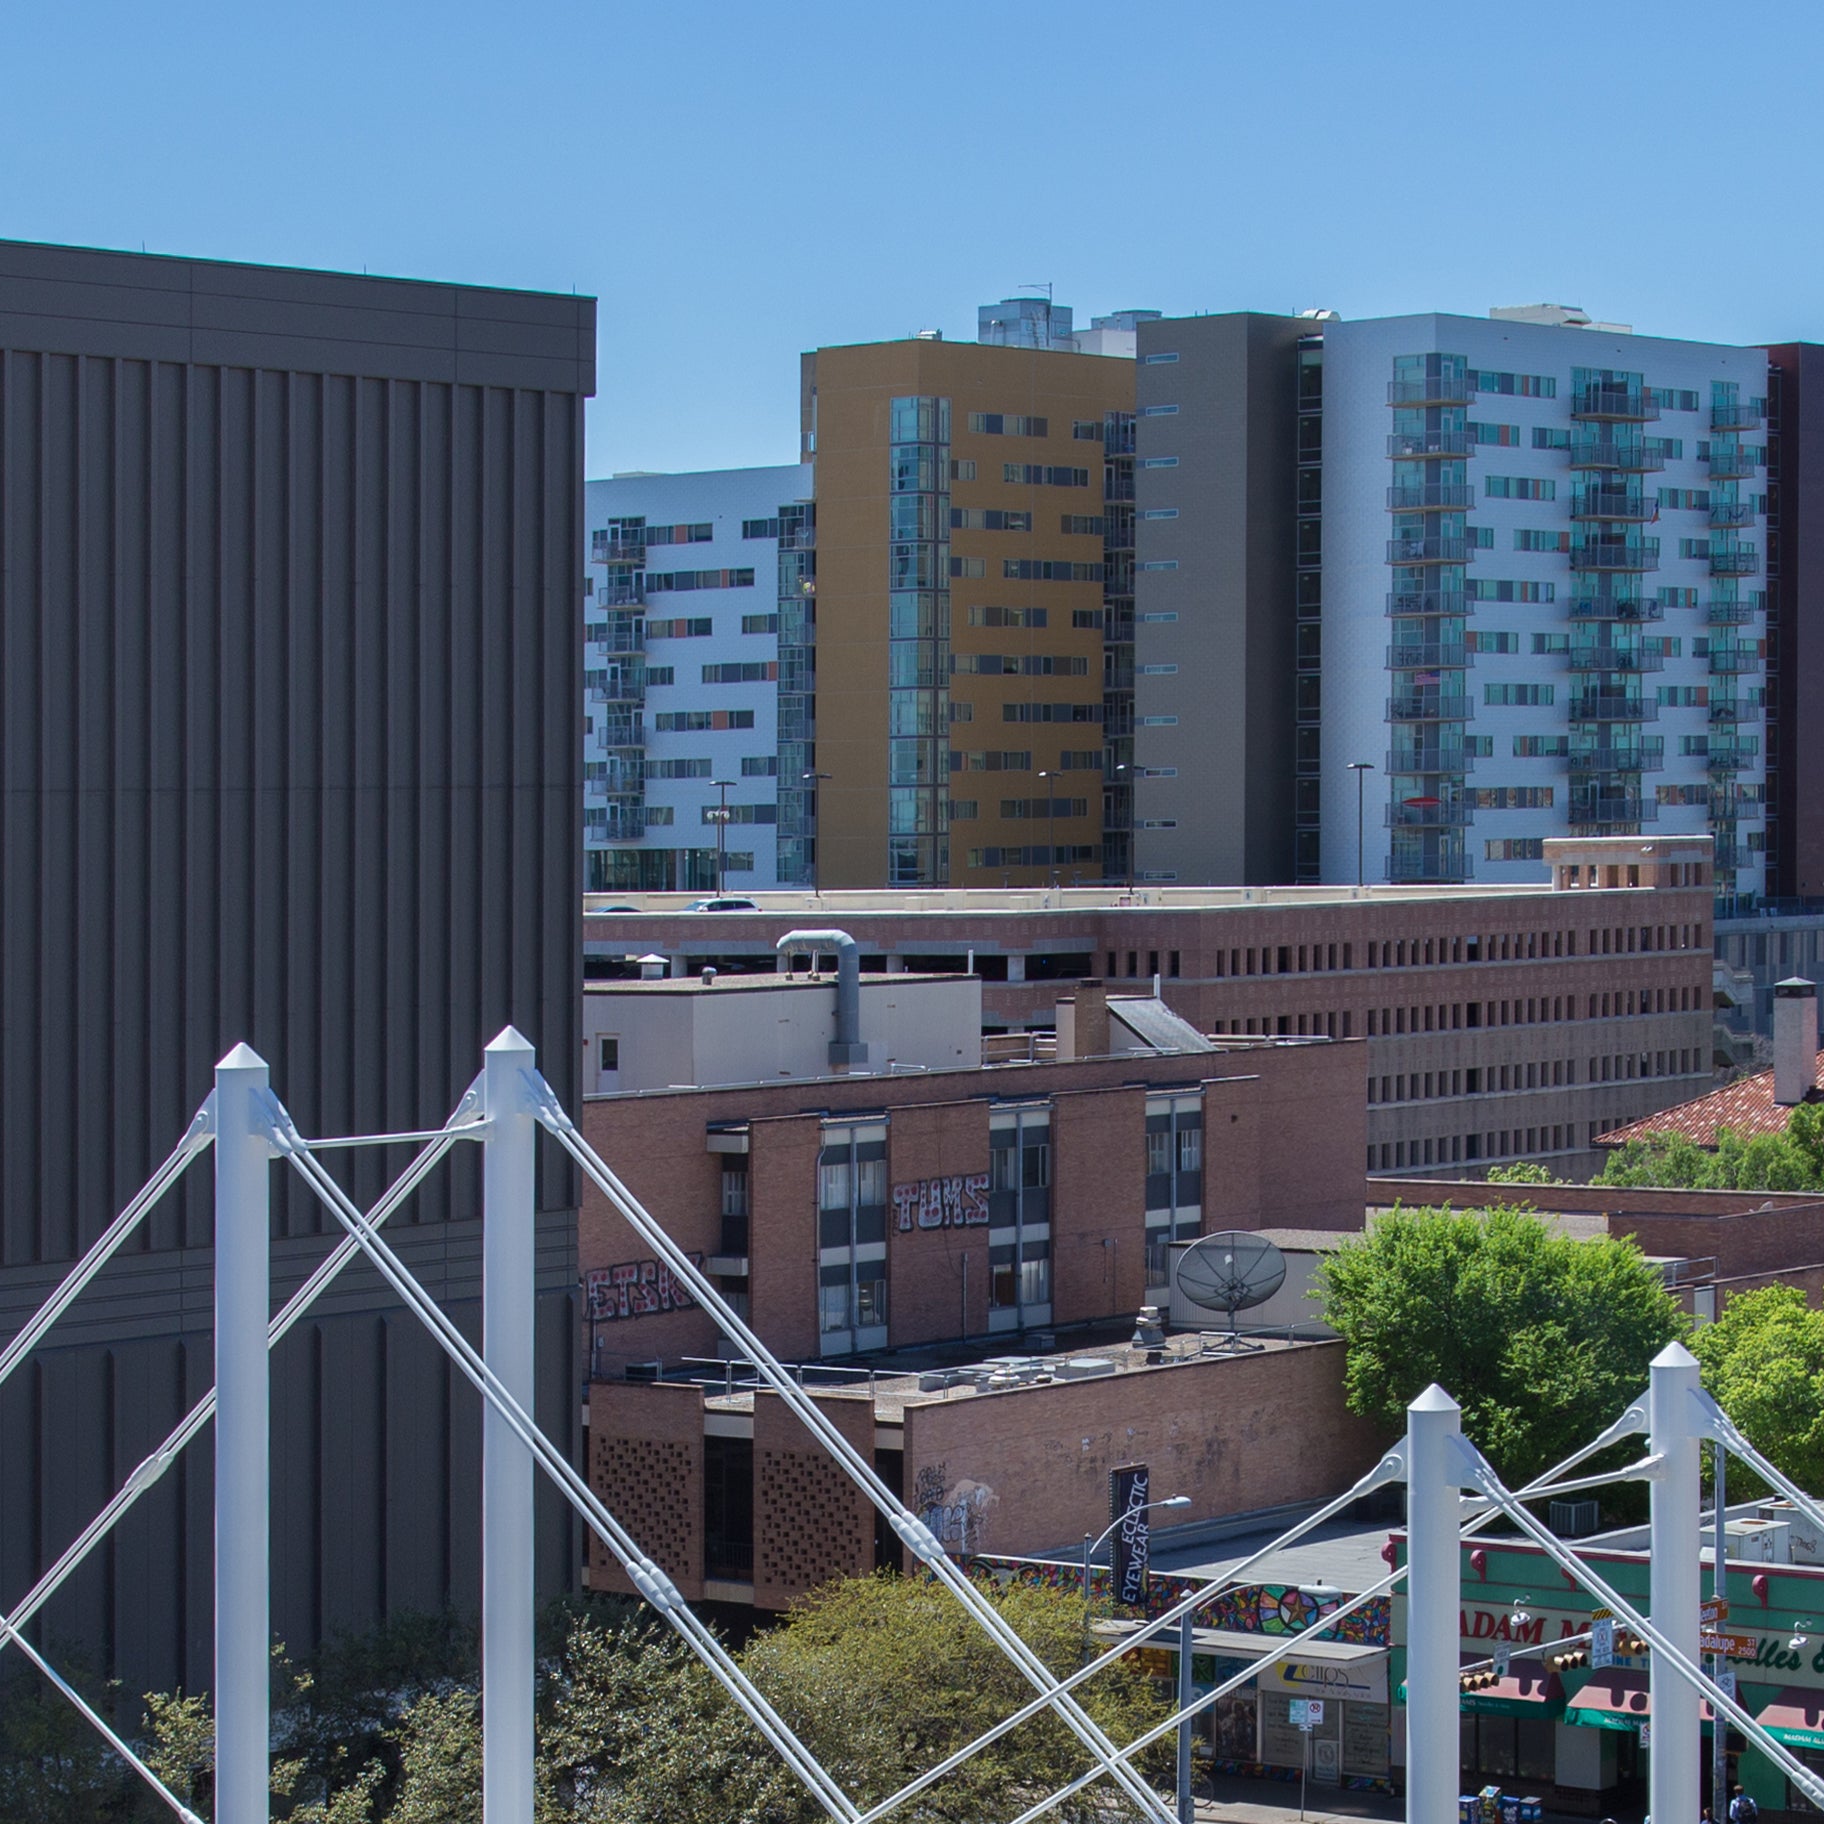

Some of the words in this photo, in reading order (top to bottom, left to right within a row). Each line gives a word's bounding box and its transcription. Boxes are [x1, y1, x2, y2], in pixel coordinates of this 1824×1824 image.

[893, 1173, 989, 1232] TUMS
[1122, 1473, 1148, 1544] ECLECTIC
[1123, 1524, 1150, 1603] EYEWEAR
[1700, 1635, 1735, 1654] adalupe
[1747, 1638, 1756, 1647] ST
